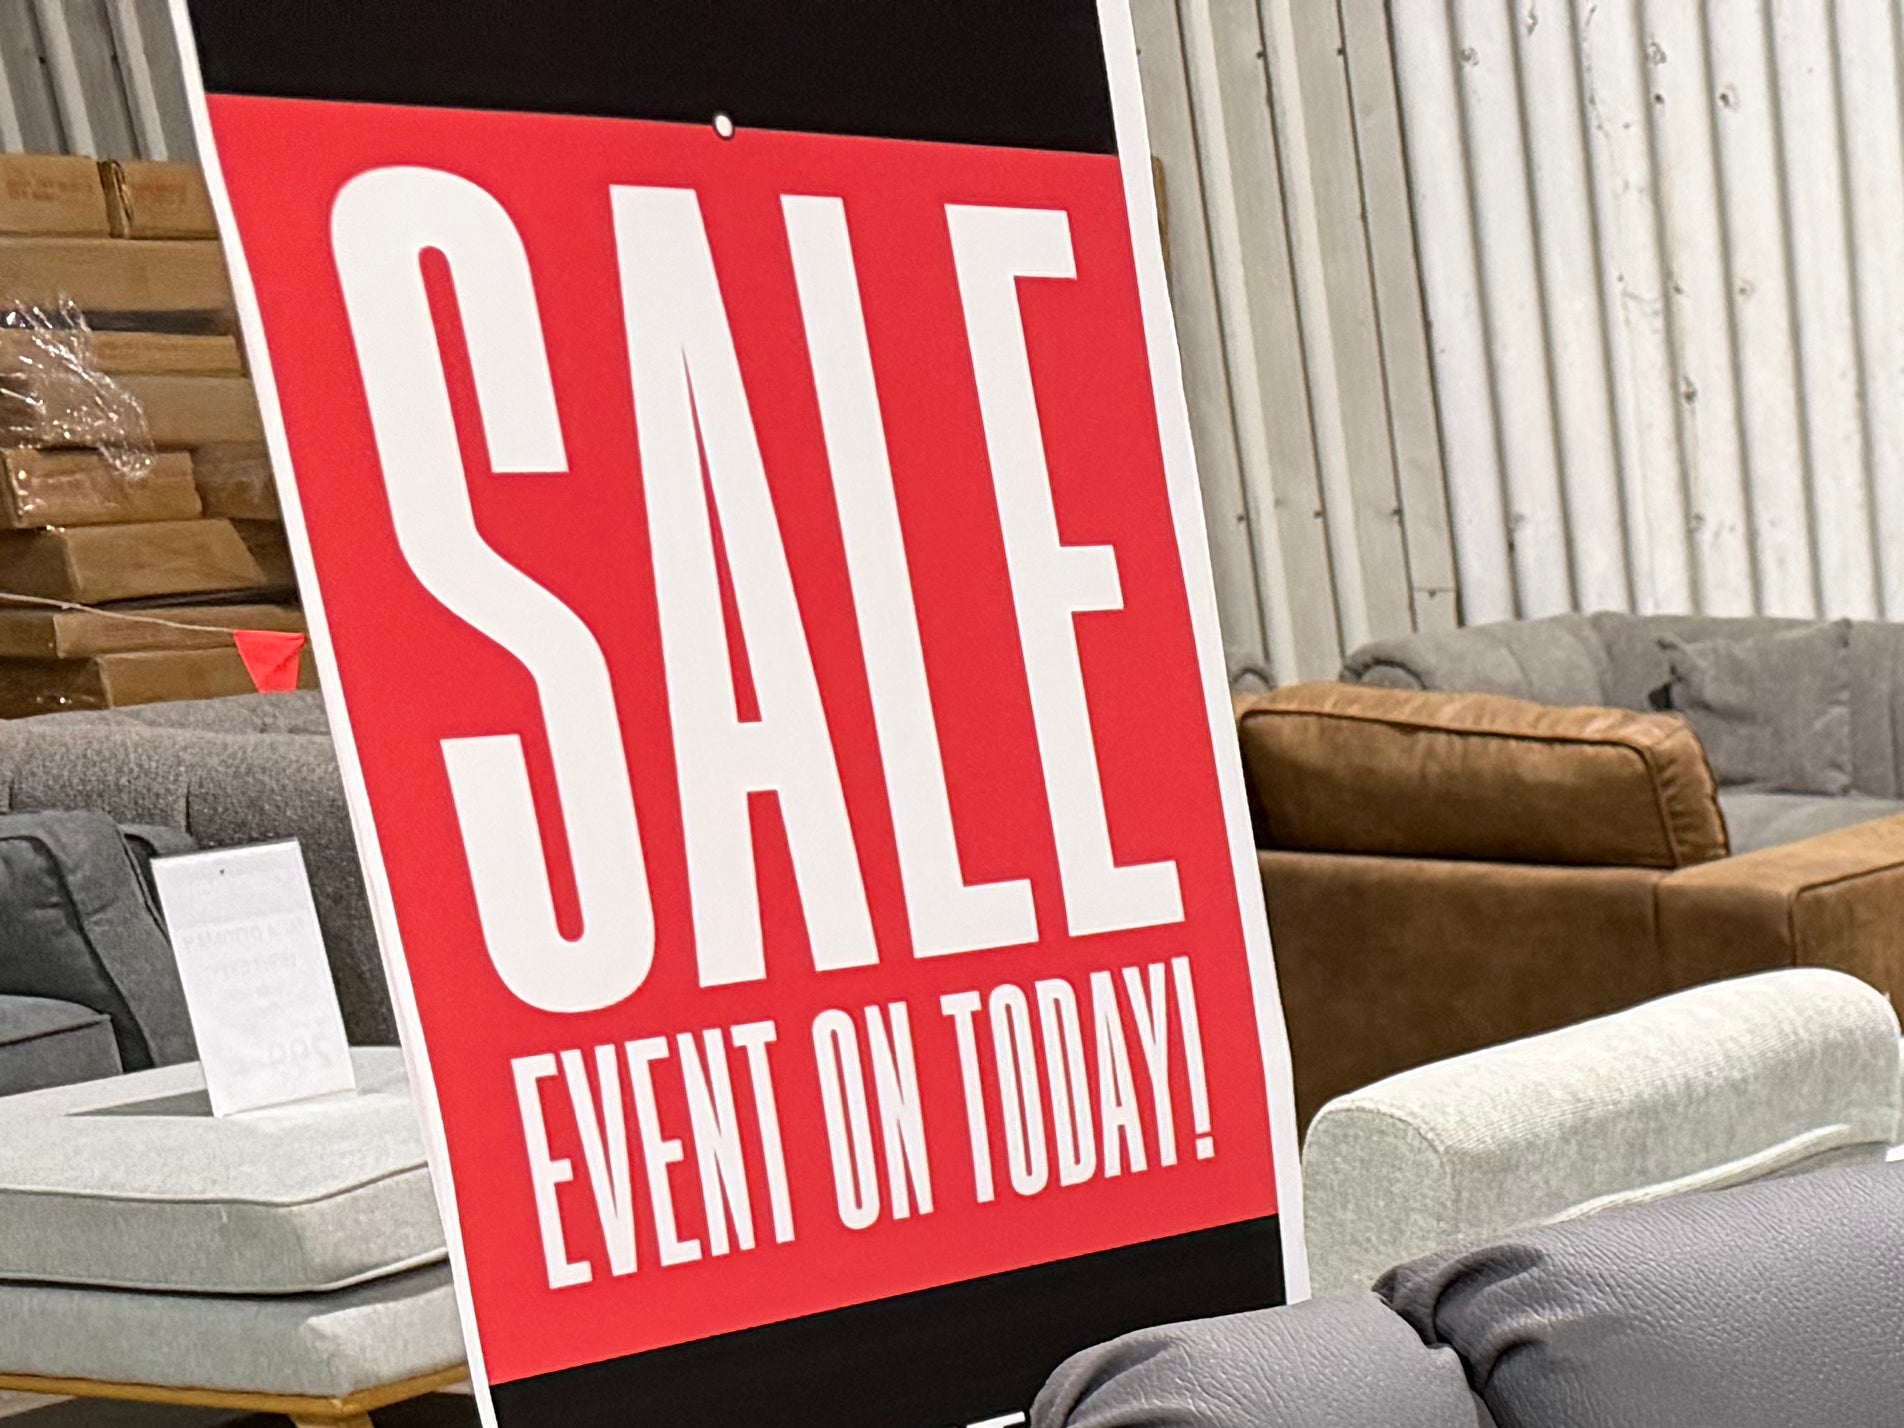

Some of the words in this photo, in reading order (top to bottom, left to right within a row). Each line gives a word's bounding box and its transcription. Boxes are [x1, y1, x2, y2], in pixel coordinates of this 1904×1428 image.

[330, 165, 1185, 1014] SALE
[510, 1018, 796, 1291] EVENT
[810, 1000, 935, 1231] ON
[938, 954, 1216, 1197] TODAY!
